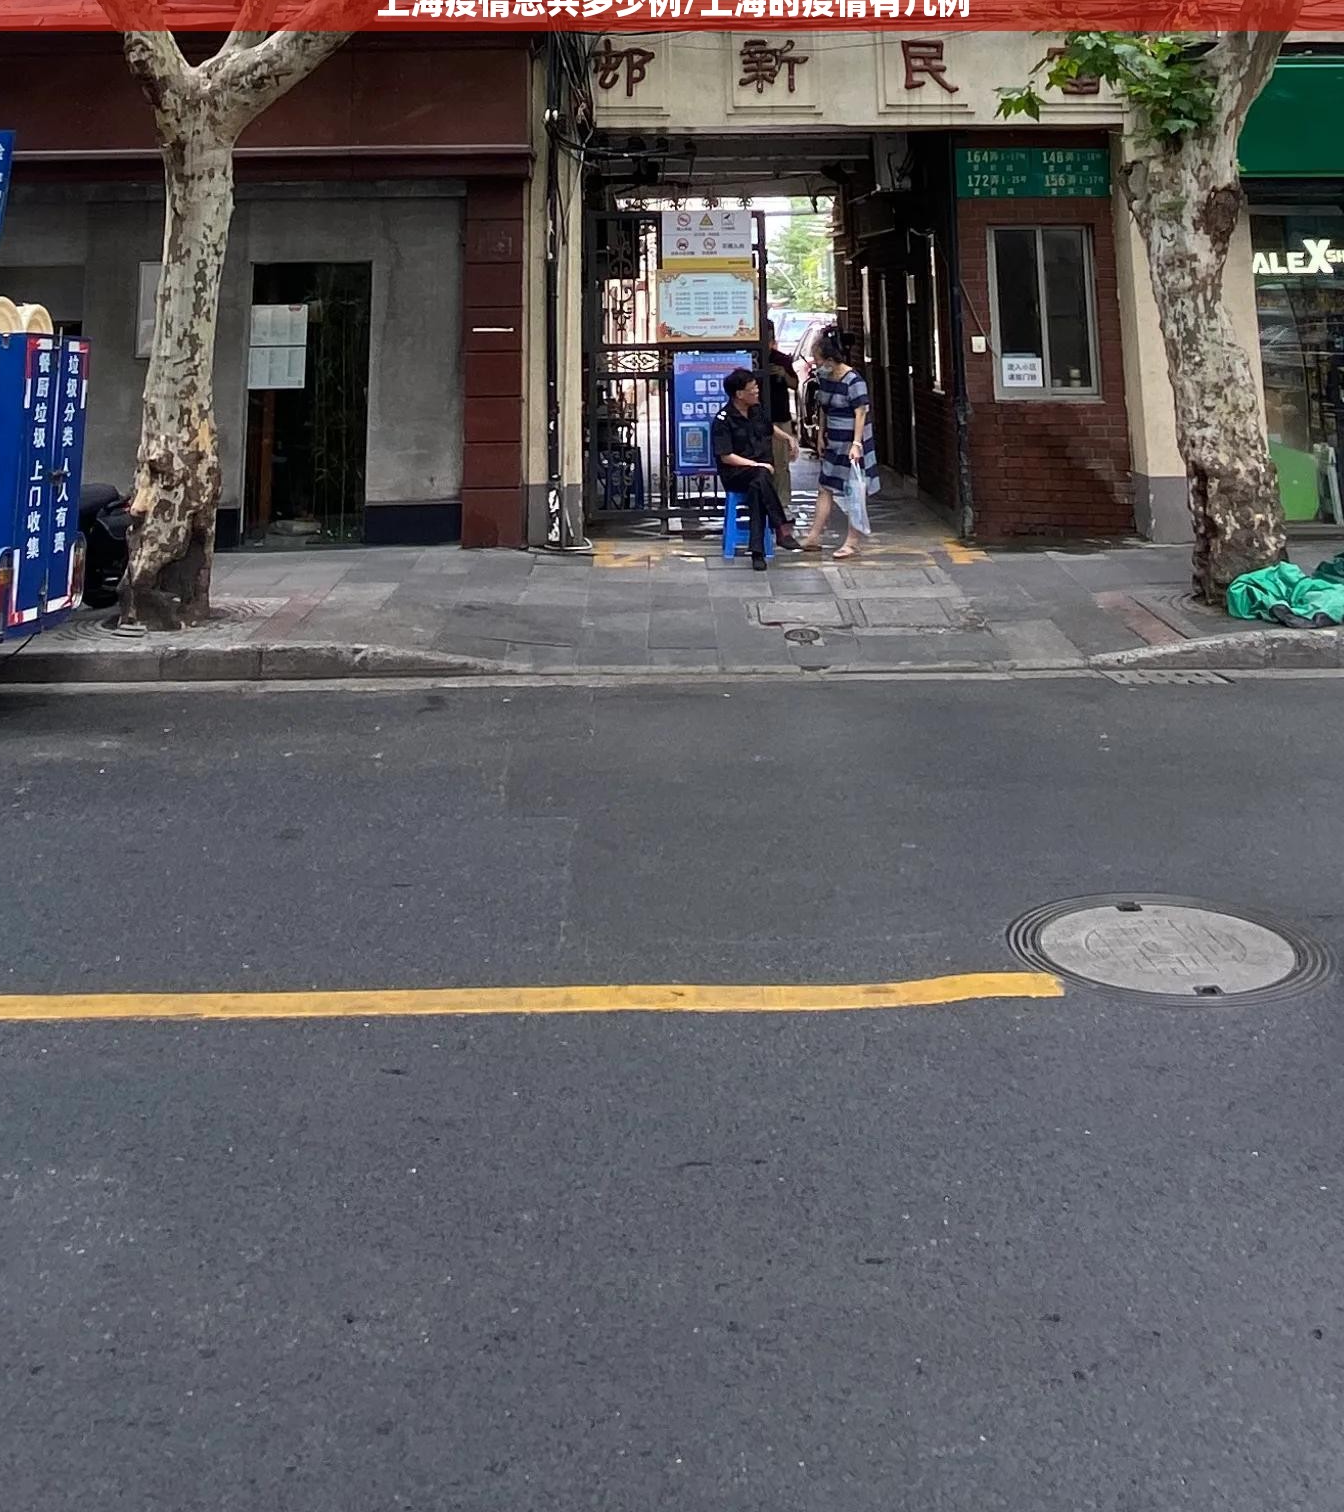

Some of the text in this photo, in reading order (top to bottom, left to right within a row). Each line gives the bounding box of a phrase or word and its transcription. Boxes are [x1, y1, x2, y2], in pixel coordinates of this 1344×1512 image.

[1252, 239, 1334, 274] ALEX
[62, 355, 80, 447] 垃圾分类
[26, 352, 51, 559] 餐厨垃圾 上门收集
